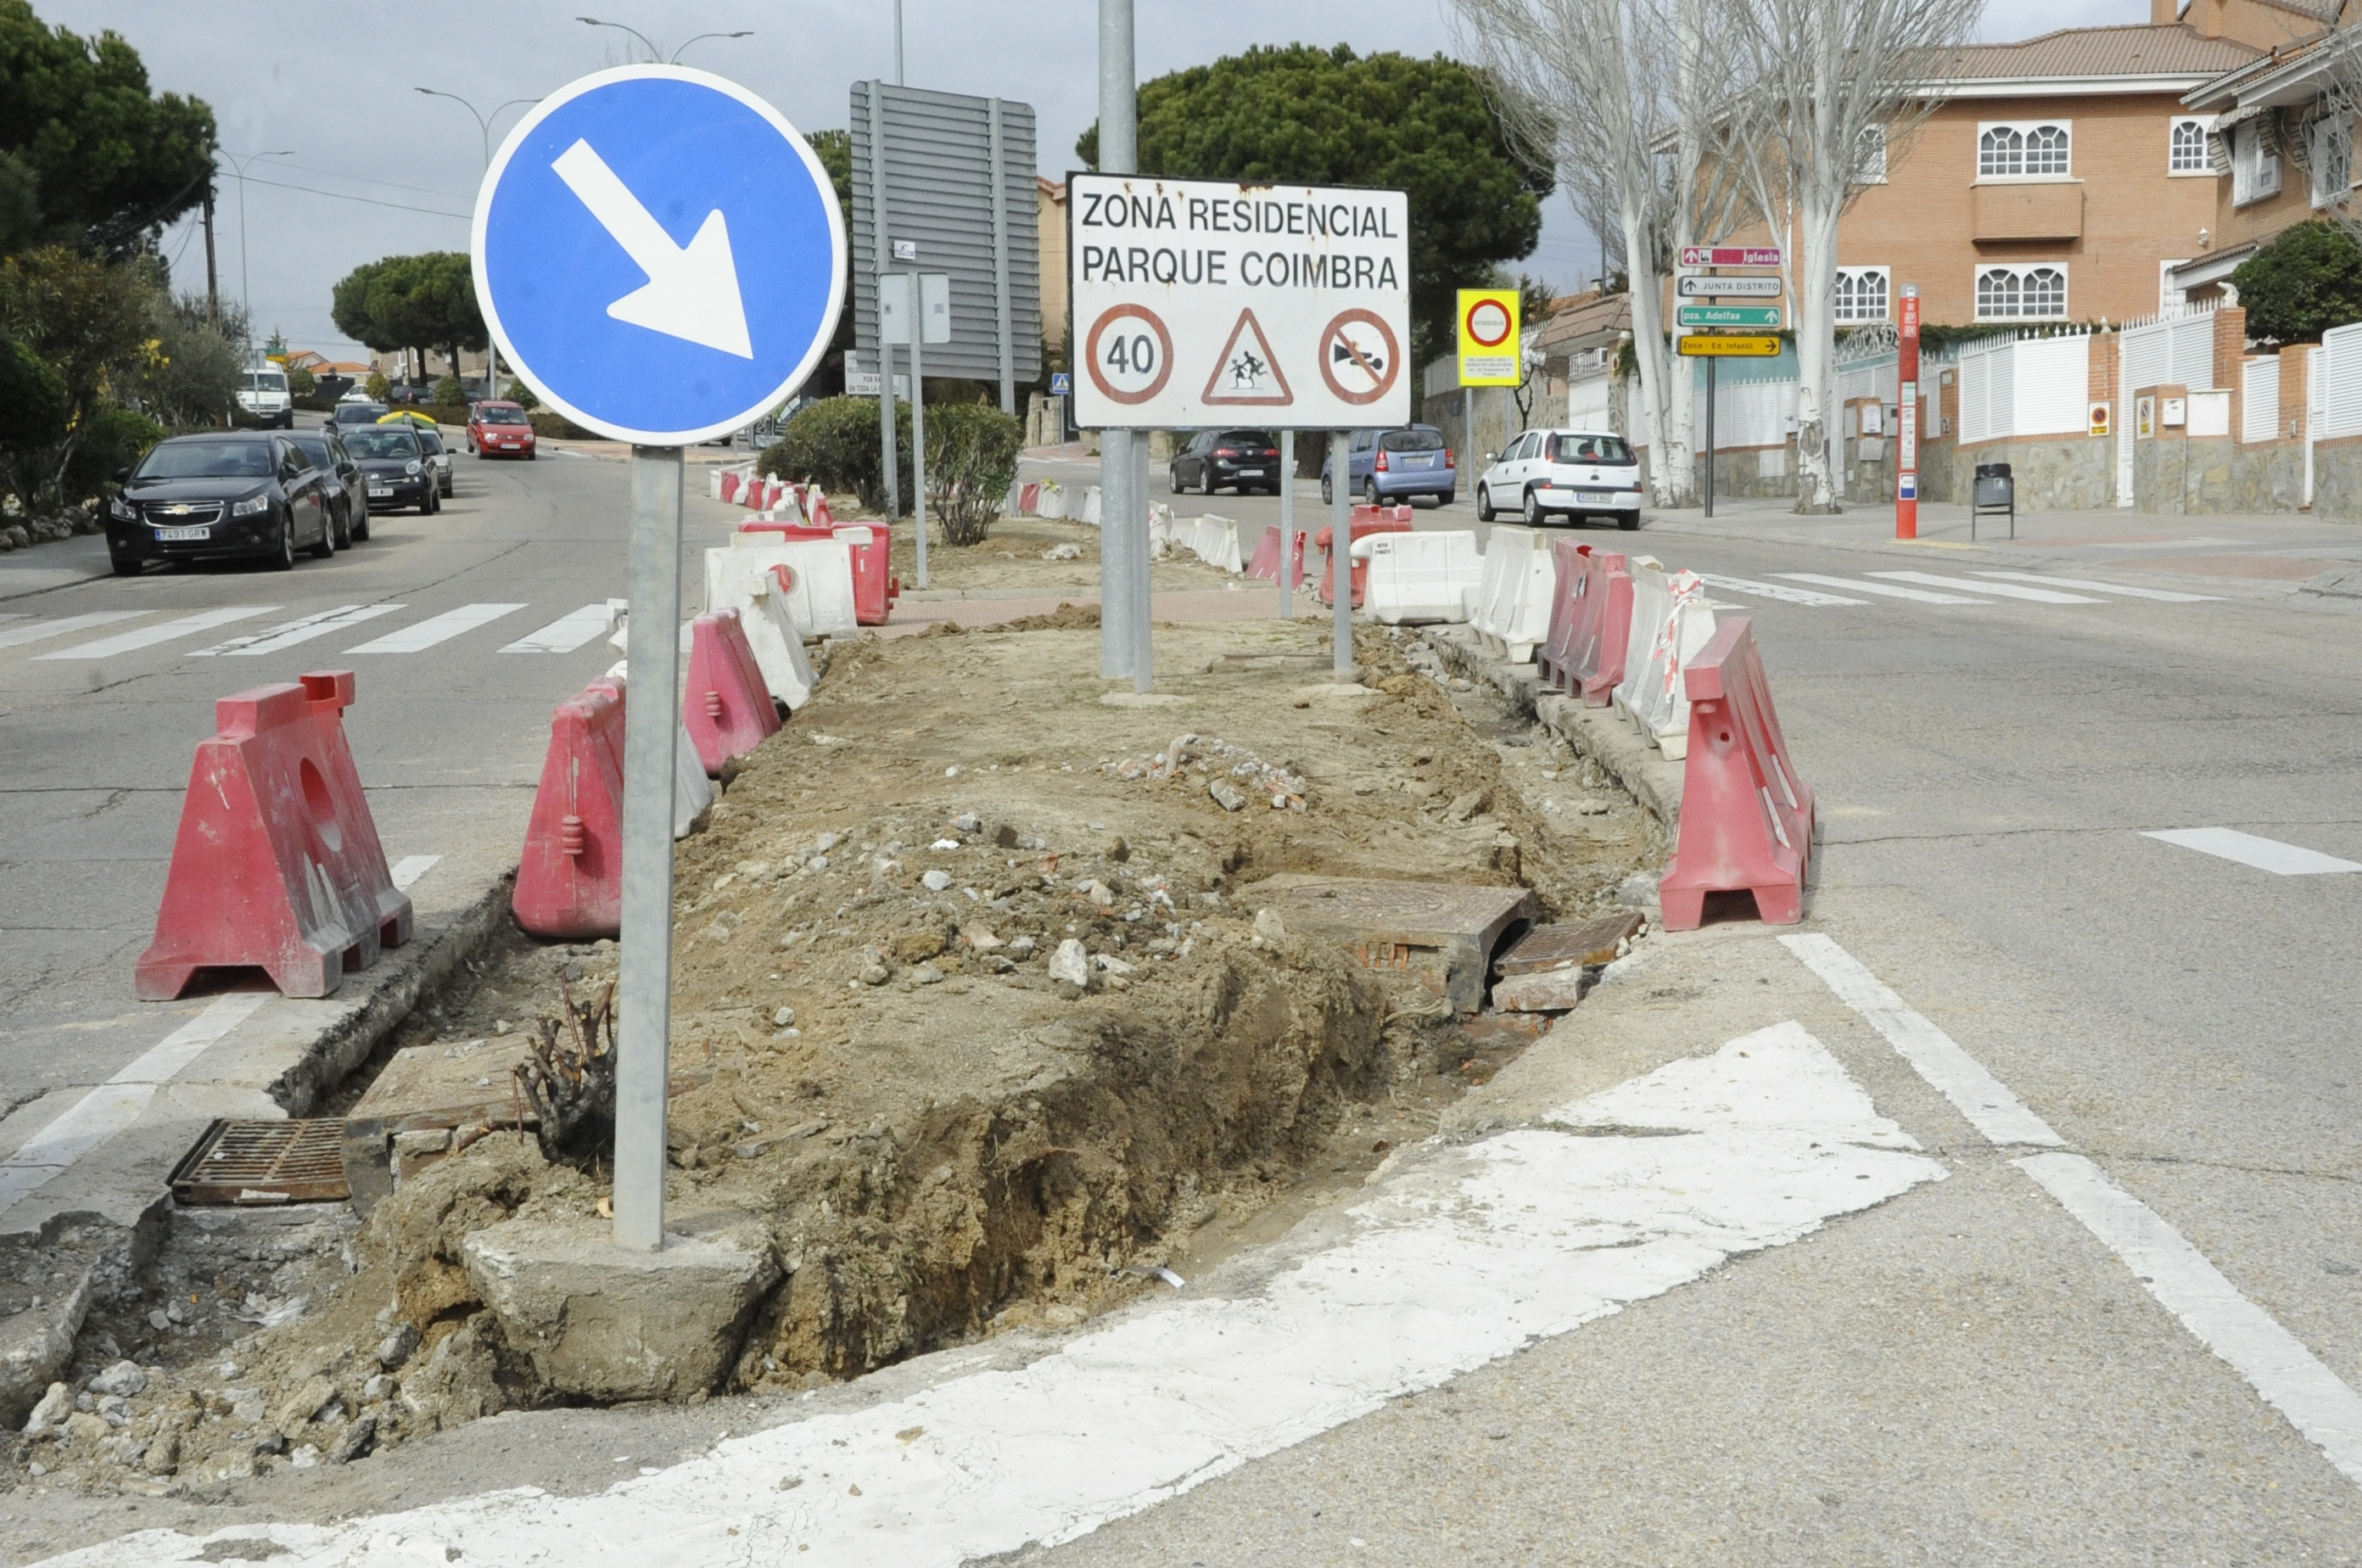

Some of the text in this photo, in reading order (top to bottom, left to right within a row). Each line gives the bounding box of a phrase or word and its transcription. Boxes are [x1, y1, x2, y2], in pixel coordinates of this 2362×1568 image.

[1082, 193, 1398, 238] ZONA RESIDENCIAL
[1744, 249, 1779, 263] Iglesia
[1083, 245, 1399, 290] PARQUE COIMBRA
[1683, 311, 1741, 321] pza. Adelfas
[1682, 341, 1703, 350] Zoco
[1106, 333, 1155, 374] 40
[161, 529, 206, 539] 7491 GRW
